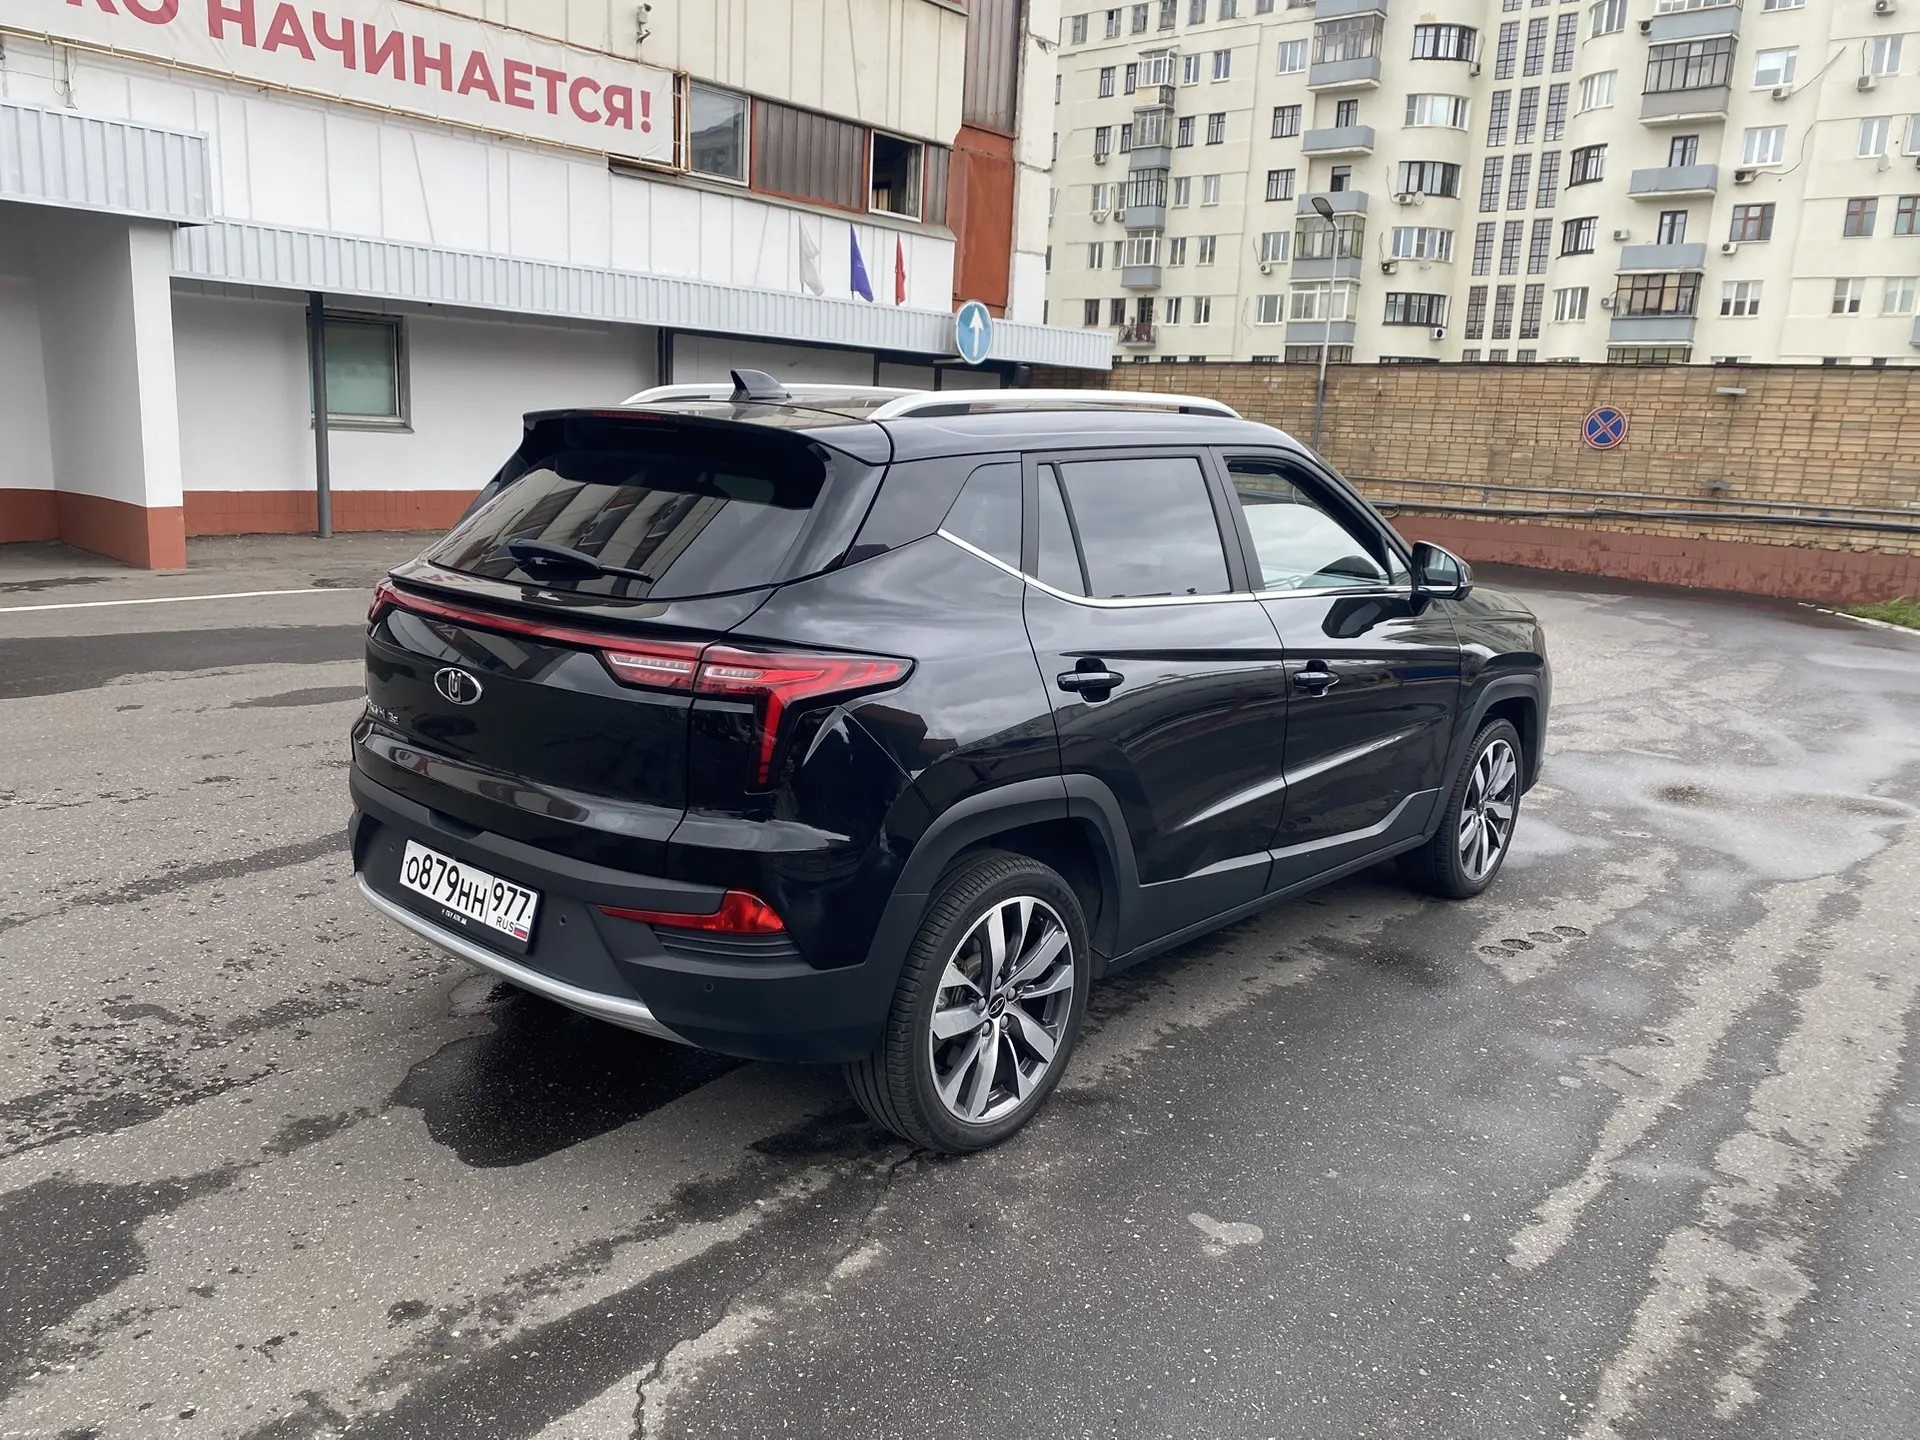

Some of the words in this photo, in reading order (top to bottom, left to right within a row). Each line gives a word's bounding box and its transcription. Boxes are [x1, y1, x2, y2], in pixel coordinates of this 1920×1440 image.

[207, 0, 651, 134] НАЧИНАЕТСЯ!
[492, 882, 531, 922] 977
[496, 916, 514, 932] RUS
